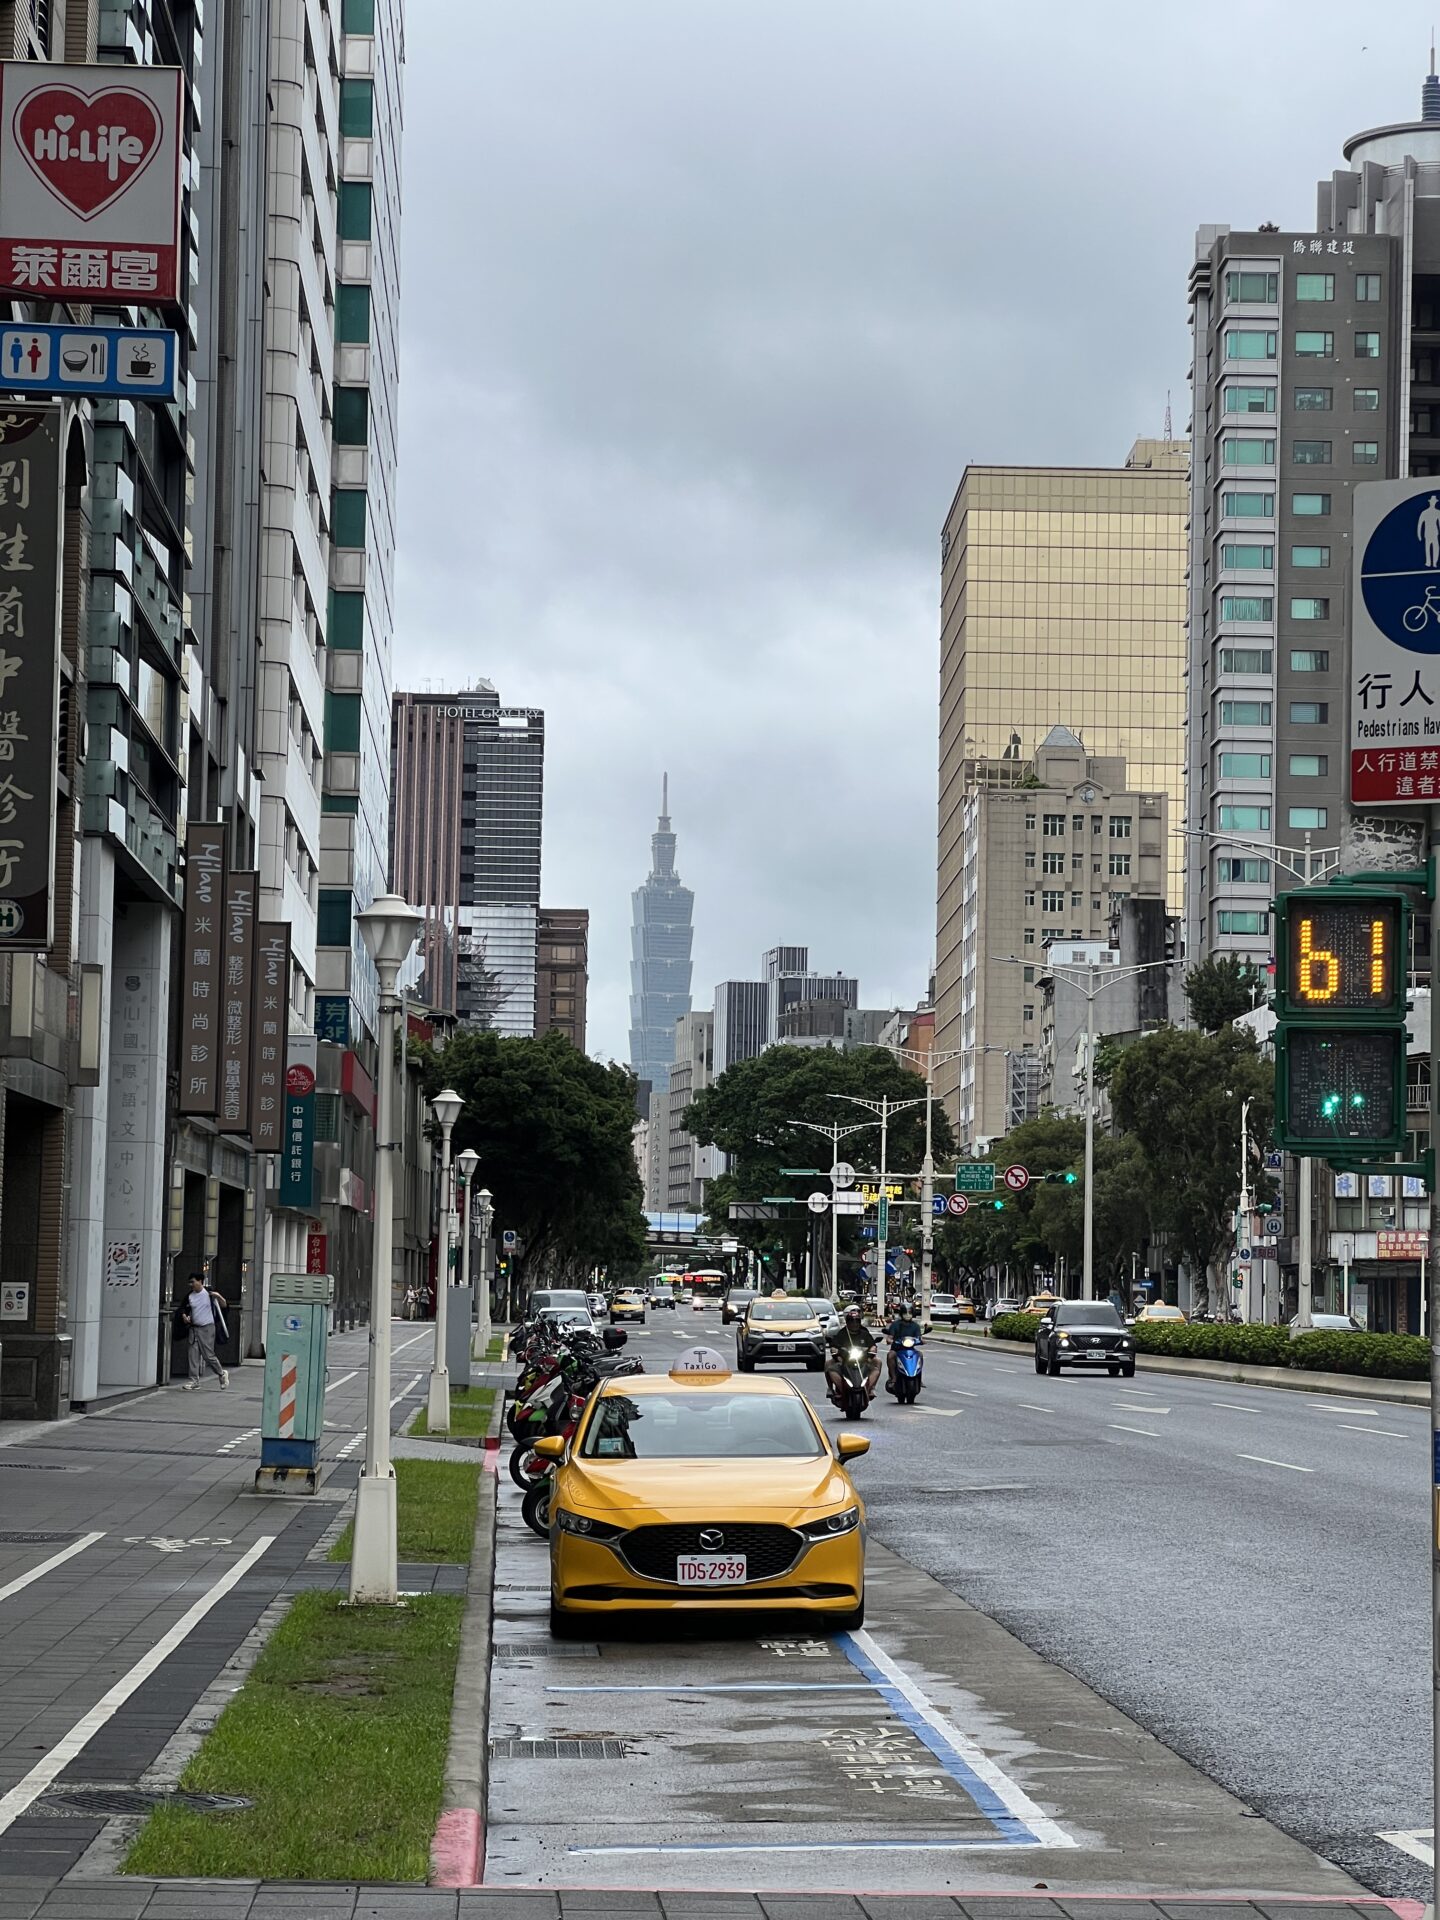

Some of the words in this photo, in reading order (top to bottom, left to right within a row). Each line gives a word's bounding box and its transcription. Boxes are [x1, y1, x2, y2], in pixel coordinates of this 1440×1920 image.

[34, 115, 143, 181] Hi-Life
[11, 245, 158, 291] 萊爾富
[1293, 239, 1355, 255] 僑聯建設
[437, 706, 478, 718] HOTEL
[481, 707, 540, 720] GRACERY
[1357, 670, 1434, 710] 行人
[1357, 718, 1420, 737] Pedestrians
[1357, 751, 1438, 773] 人行道禁
[1395, 775, 1440, 796] 違者
[188, 843, 222, 904] Milano
[227, 889, 253, 944] Milano
[259, 937, 286, 986] Milano
[189, 916, 213, 1095] 米蘭時尚診所
[258, 996, 278, 1137] 米蘭時尚診所
[290, 1105, 303, 1182] 中國信託銀行
[684, 1362, 717, 1370] TaxiGo
